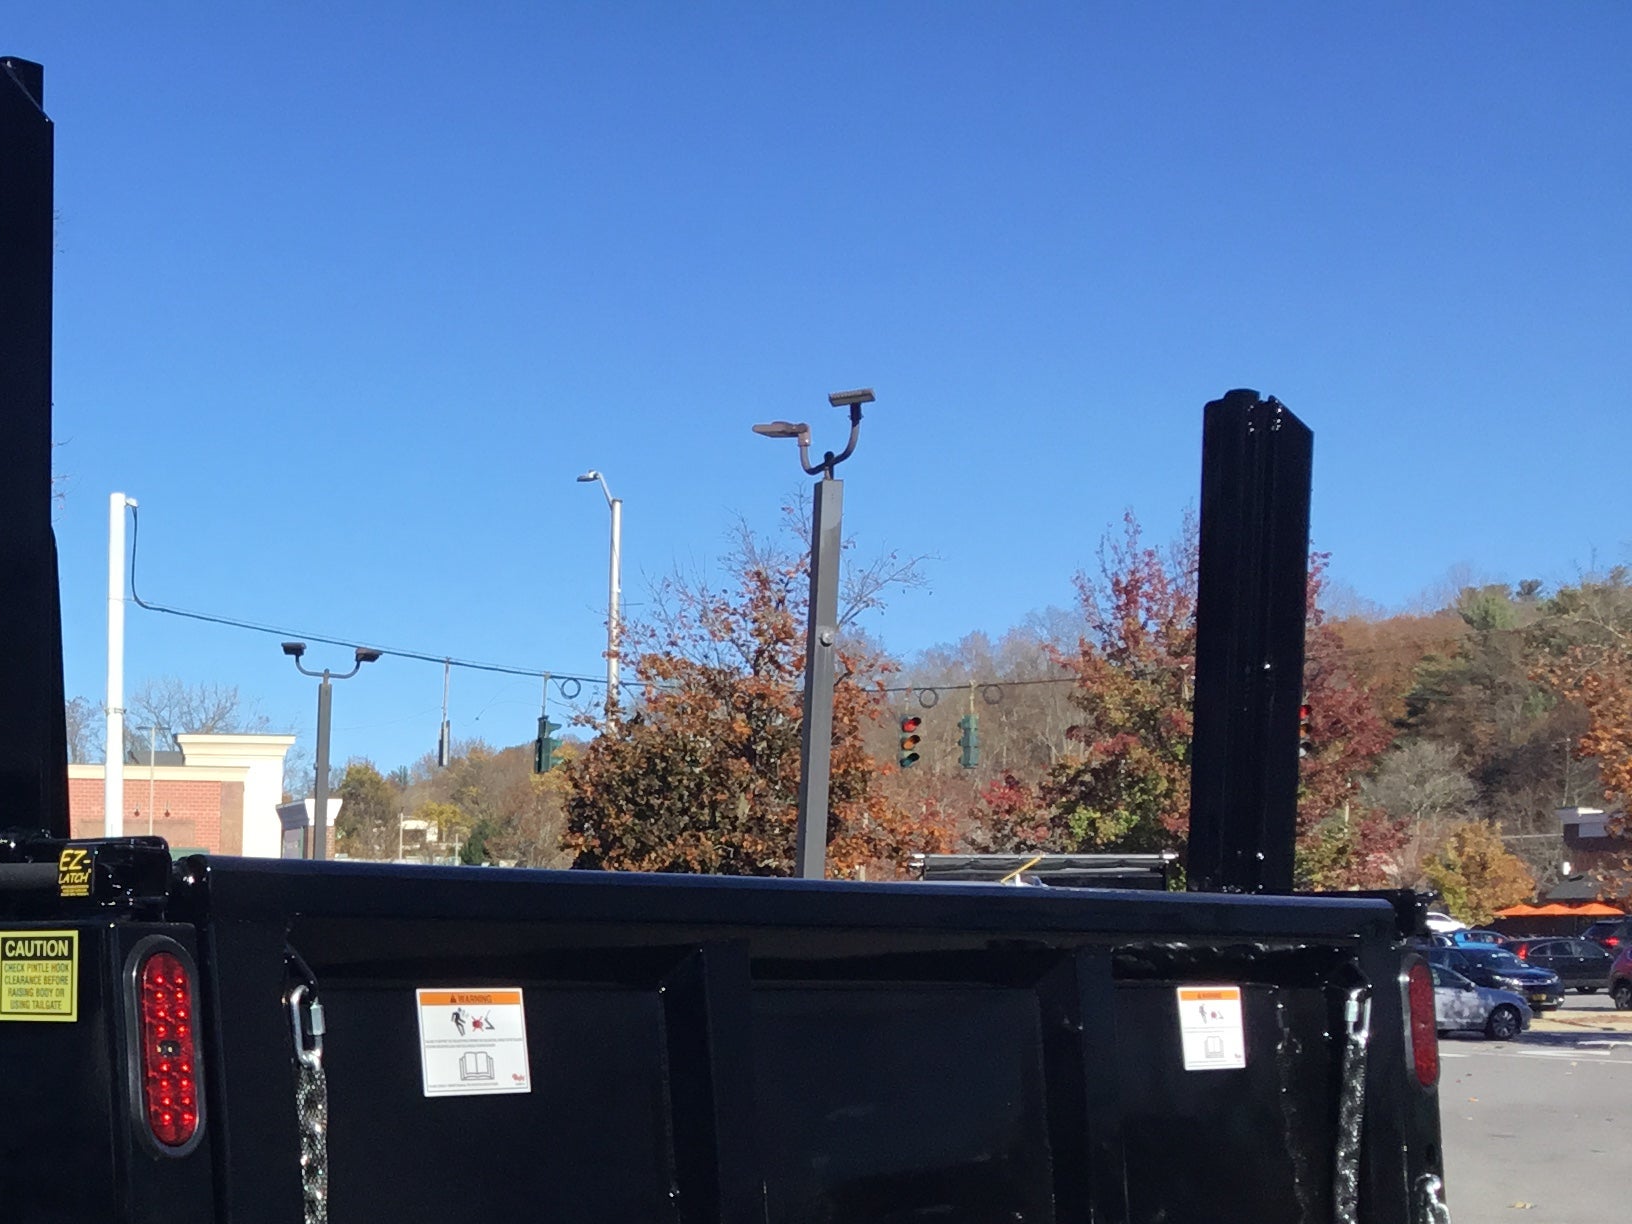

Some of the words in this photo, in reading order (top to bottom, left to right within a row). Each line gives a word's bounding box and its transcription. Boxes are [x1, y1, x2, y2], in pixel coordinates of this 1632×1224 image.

[5, 940, 69, 957] CAUTION
[4, 963, 24, 973] CHECK
[26, 963, 49, 973] PINTLE
[51, 963, 69, 973] HOOK
[4, 975, 41, 985] CLEARANCE
[43, 976, 68, 985] BEFORE
[32, 1000, 62, 1010] TAILGATE
